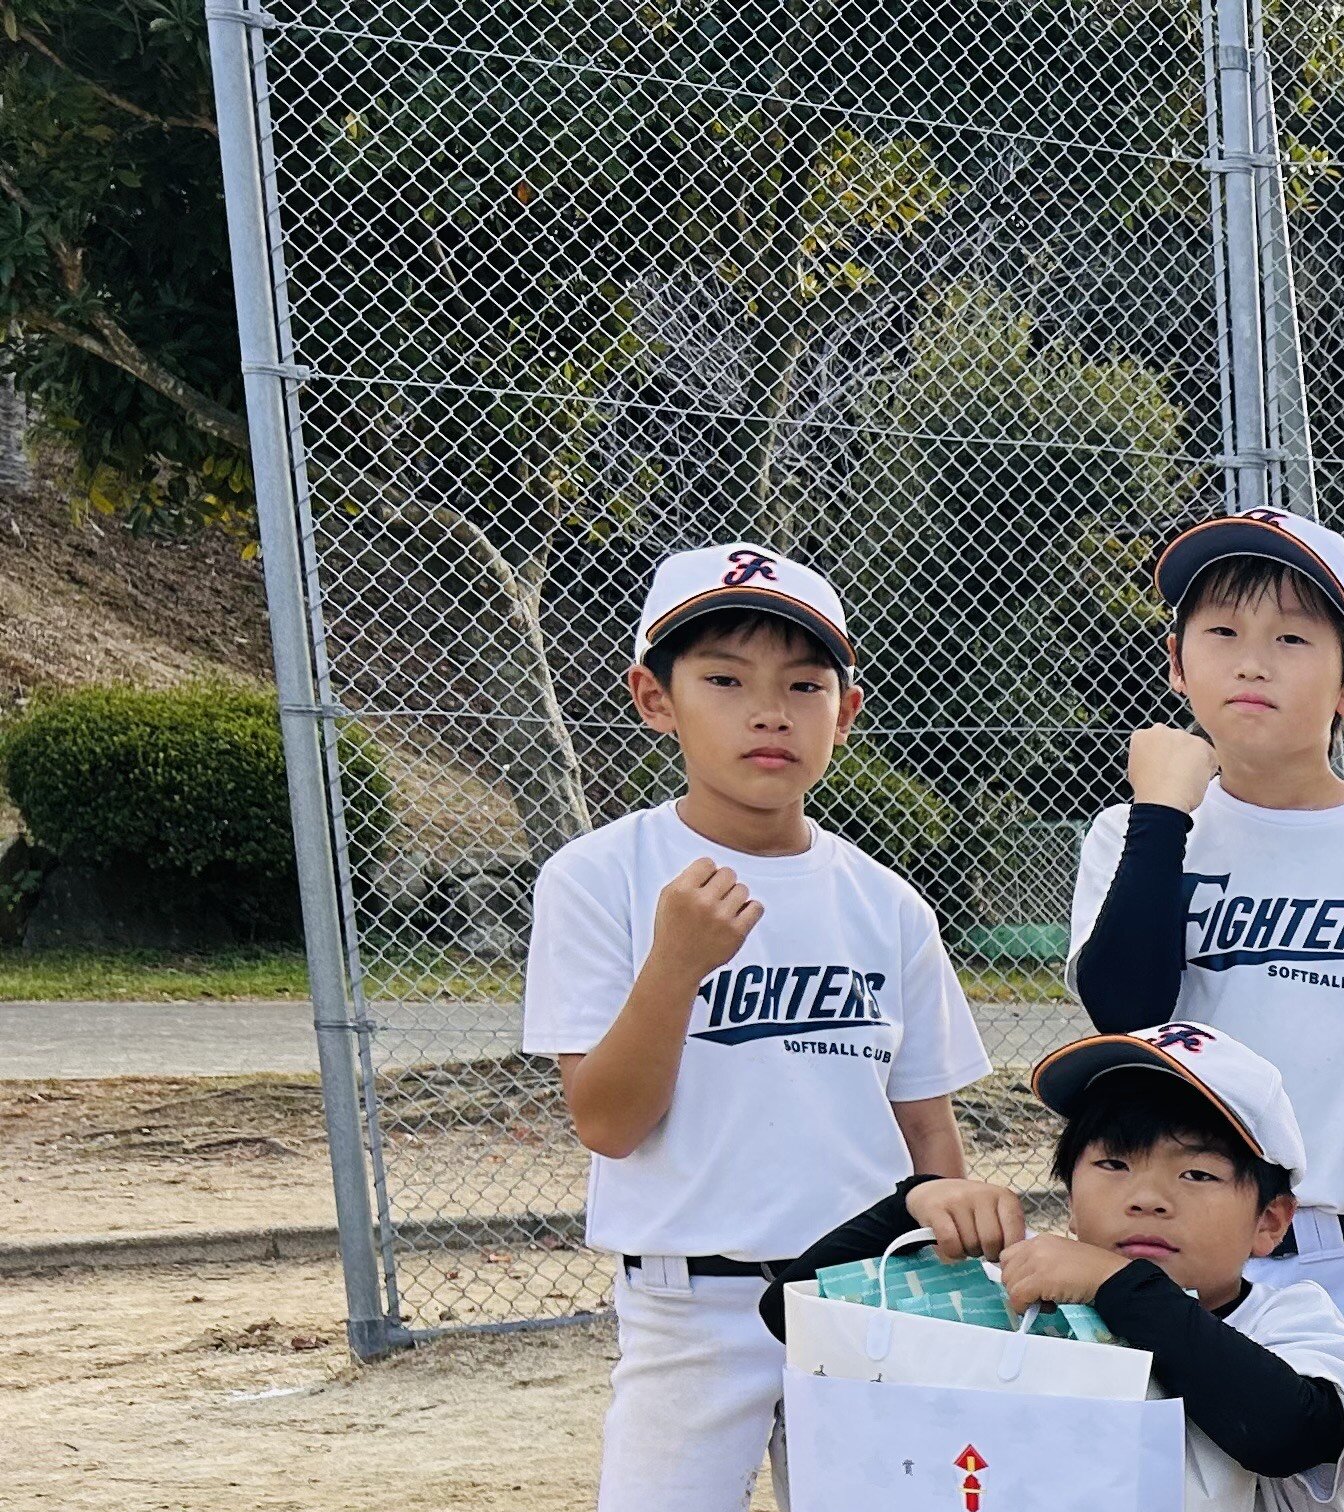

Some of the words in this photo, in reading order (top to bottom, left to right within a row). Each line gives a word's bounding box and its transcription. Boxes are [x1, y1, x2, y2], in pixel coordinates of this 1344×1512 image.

[697, 964, 886, 1028] IGHTERS
[783, 1039, 859, 1058] SOFTBALL
[862, 1046, 892, 1064] CUB
